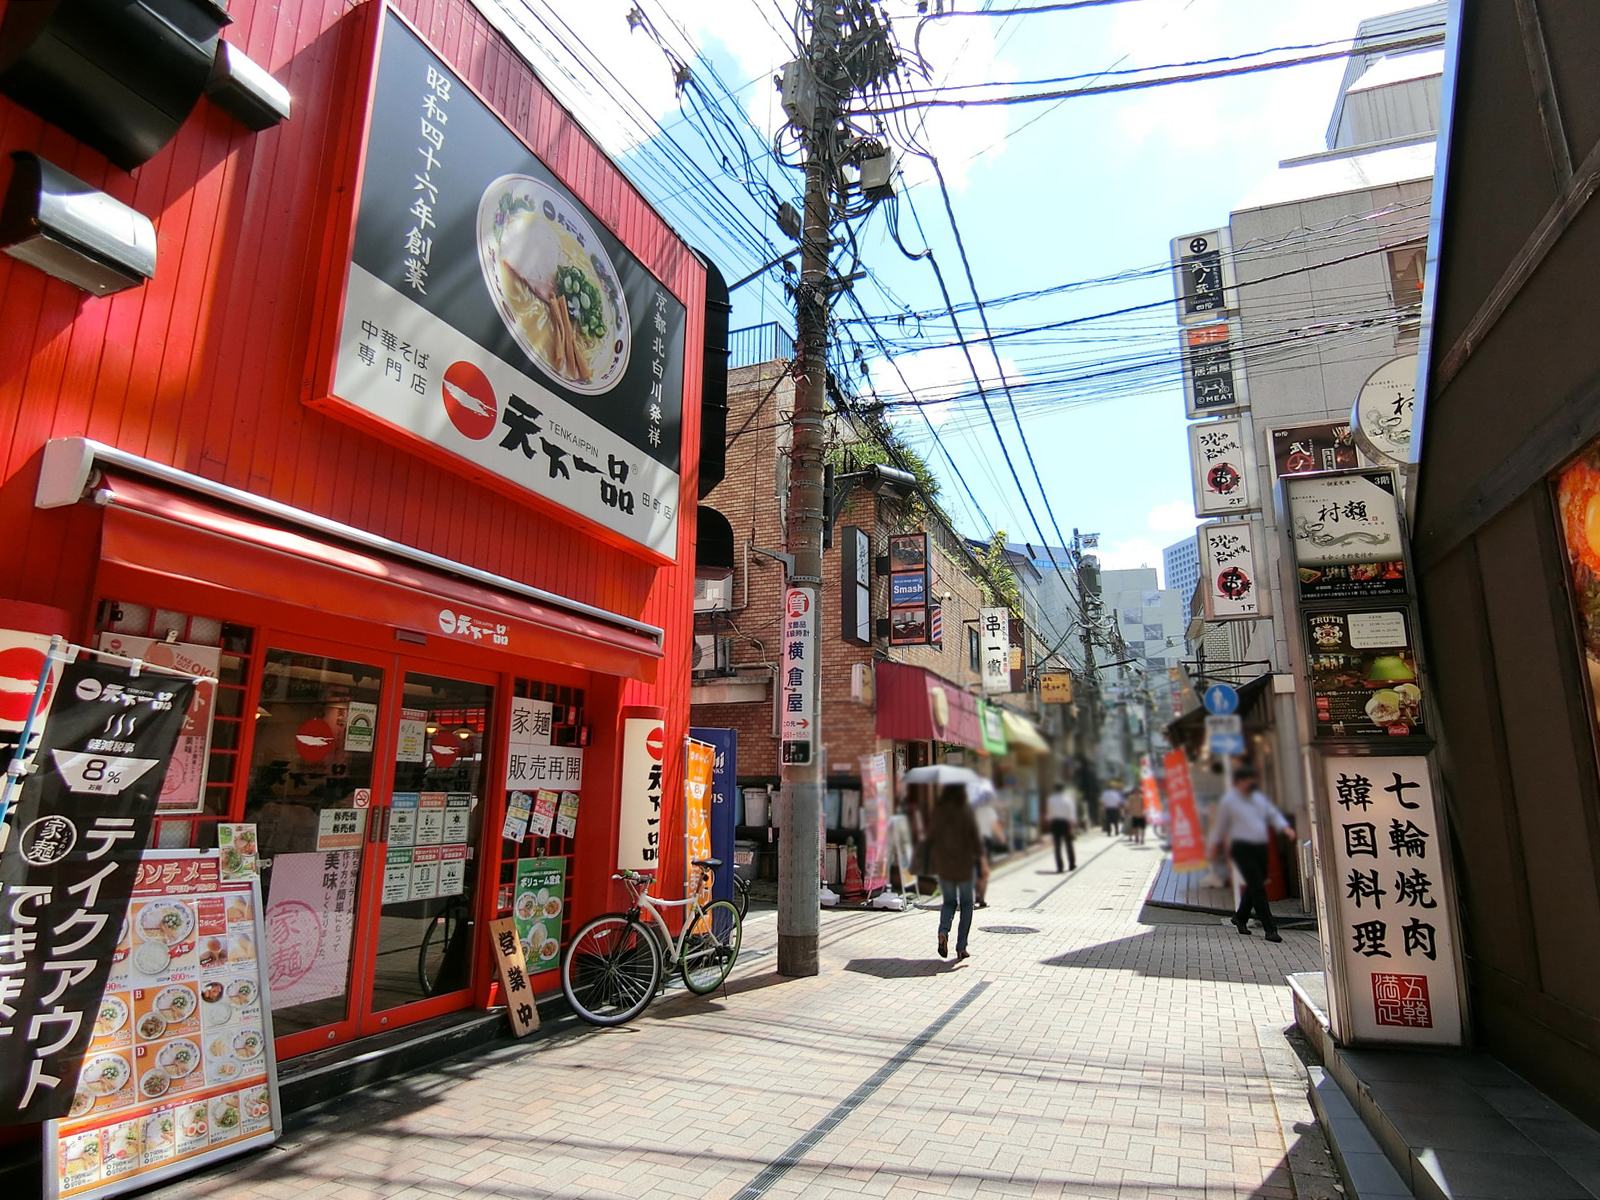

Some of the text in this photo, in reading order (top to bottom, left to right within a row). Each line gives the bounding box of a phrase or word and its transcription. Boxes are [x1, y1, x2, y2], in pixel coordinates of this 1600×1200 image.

[404, 64, 452, 296] 昭和四十六年創業
[360, 319, 431, 370] 中華そば
[1199, 329, 1218, 343] 3F
[356, 343, 428, 396] 専門店
[647, 290, 668, 449] 京都北白川発祥
[1391, 391, 1415, 416] 村
[499, 393, 635, 516] 天下一品
[549, 419, 600, 459] TENKAIPPIN
[1374, 475, 1390, 485] 3階
[641, 491, 673, 520] 田町店
[1228, 497, 1244, 505] 2F
[893, 583, 923, 594] Smash
[1240, 603, 1256, 612] 1F
[1309, 615, 1345, 626] TRUTH
[457, 614, 510, 646] 天下一品
[786, 641, 805, 714] 横倉屋
[100, 683, 174, 711] 天下一品
[512, 706, 551, 738] 家麺
[81, 758, 123, 784] 8%
[507, 751, 583, 782] 販売再開
[27, 818, 67, 862] 家麺
[1336, 772, 1393, 959] 韓国料理
[1384, 771, 1438, 962] 七輪焼肉
[18, 818, 137, 1110] テイクアウト
[498, 930, 533, 1028] 営業中
